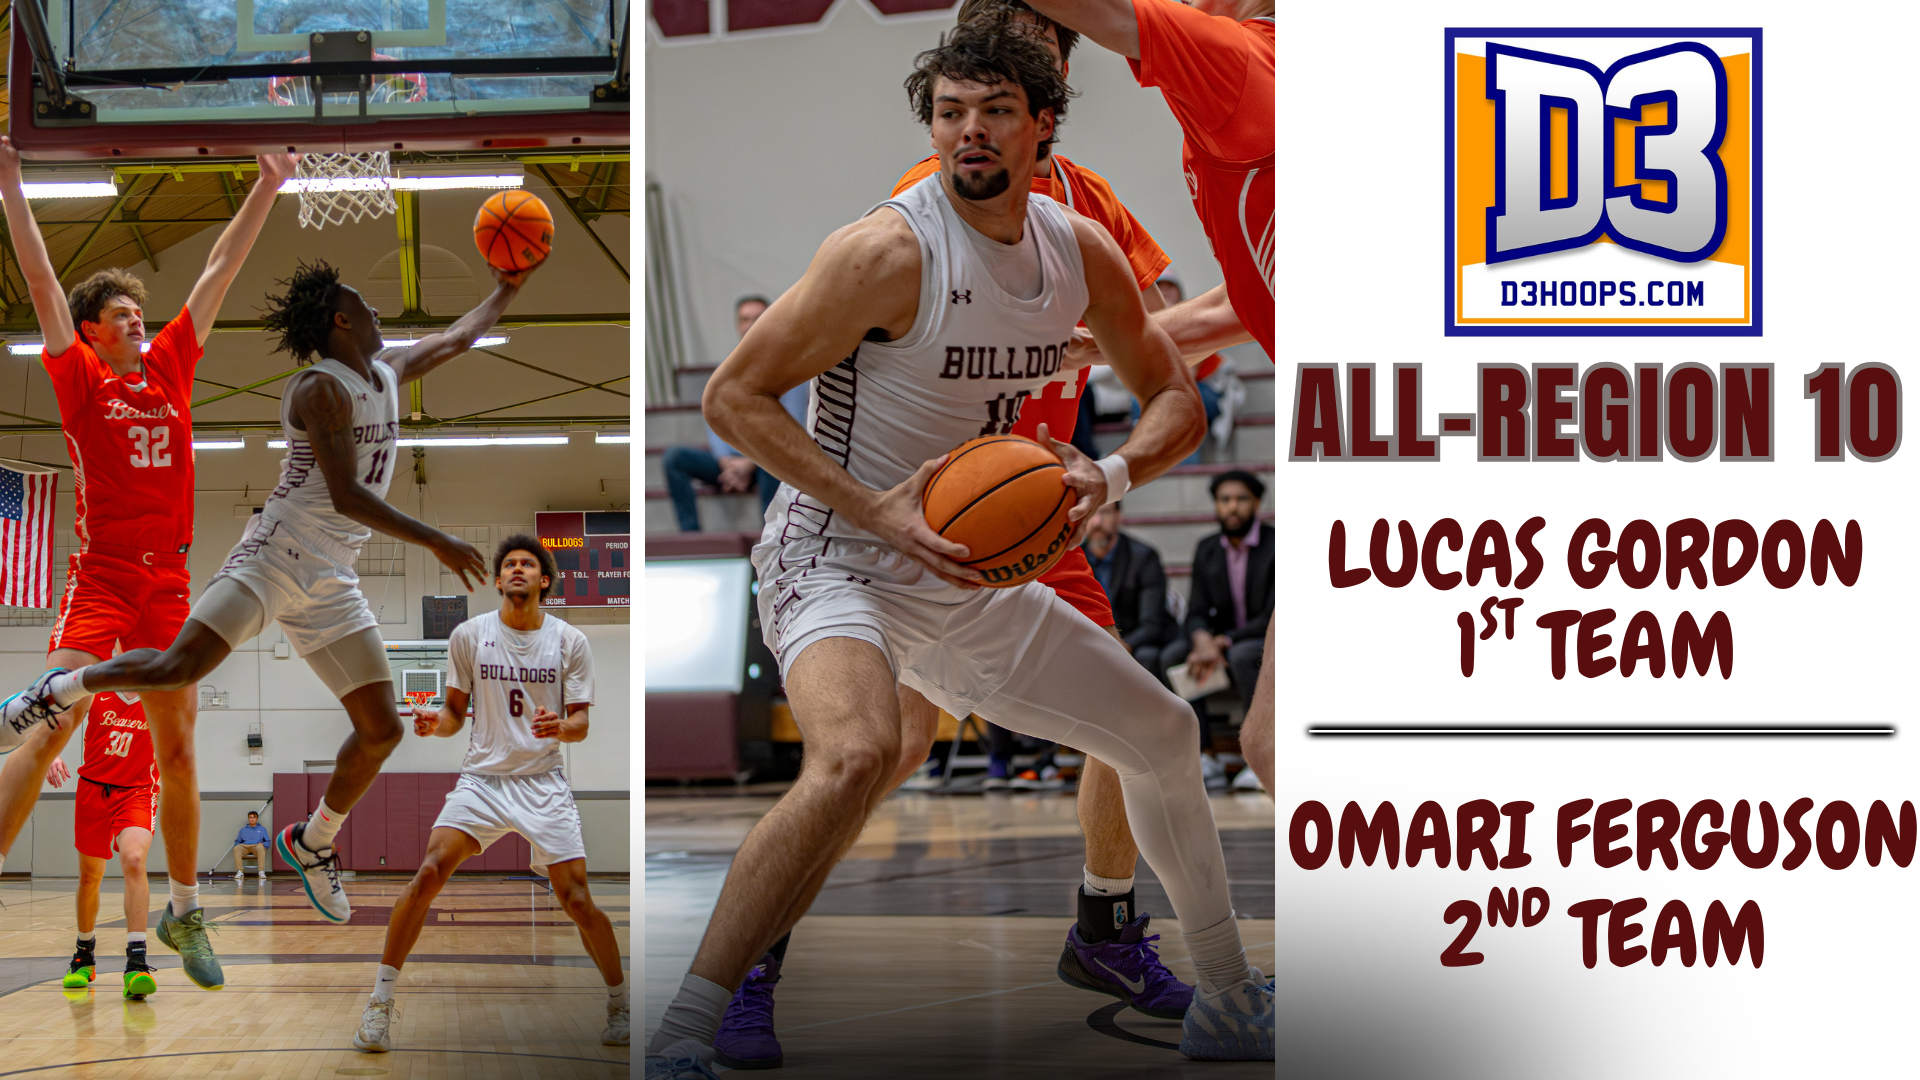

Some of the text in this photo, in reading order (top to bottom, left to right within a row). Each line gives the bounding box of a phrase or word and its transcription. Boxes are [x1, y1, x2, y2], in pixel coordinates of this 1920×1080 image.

[127, 425, 172, 468] 32
[364, 448, 388, 484] 11
[542, 538, 584, 547] BULLDOGS
[980, 522, 1071, 584] Wilson
[142, 552, 154, 565] C
[572, 571, 590, 579] T.O.L.
[480, 664, 556, 684] BULLDOGS
[509, 689, 524, 717] 6
[99, 710, 150, 731] Beavers
[104, 730, 134, 758] 30
